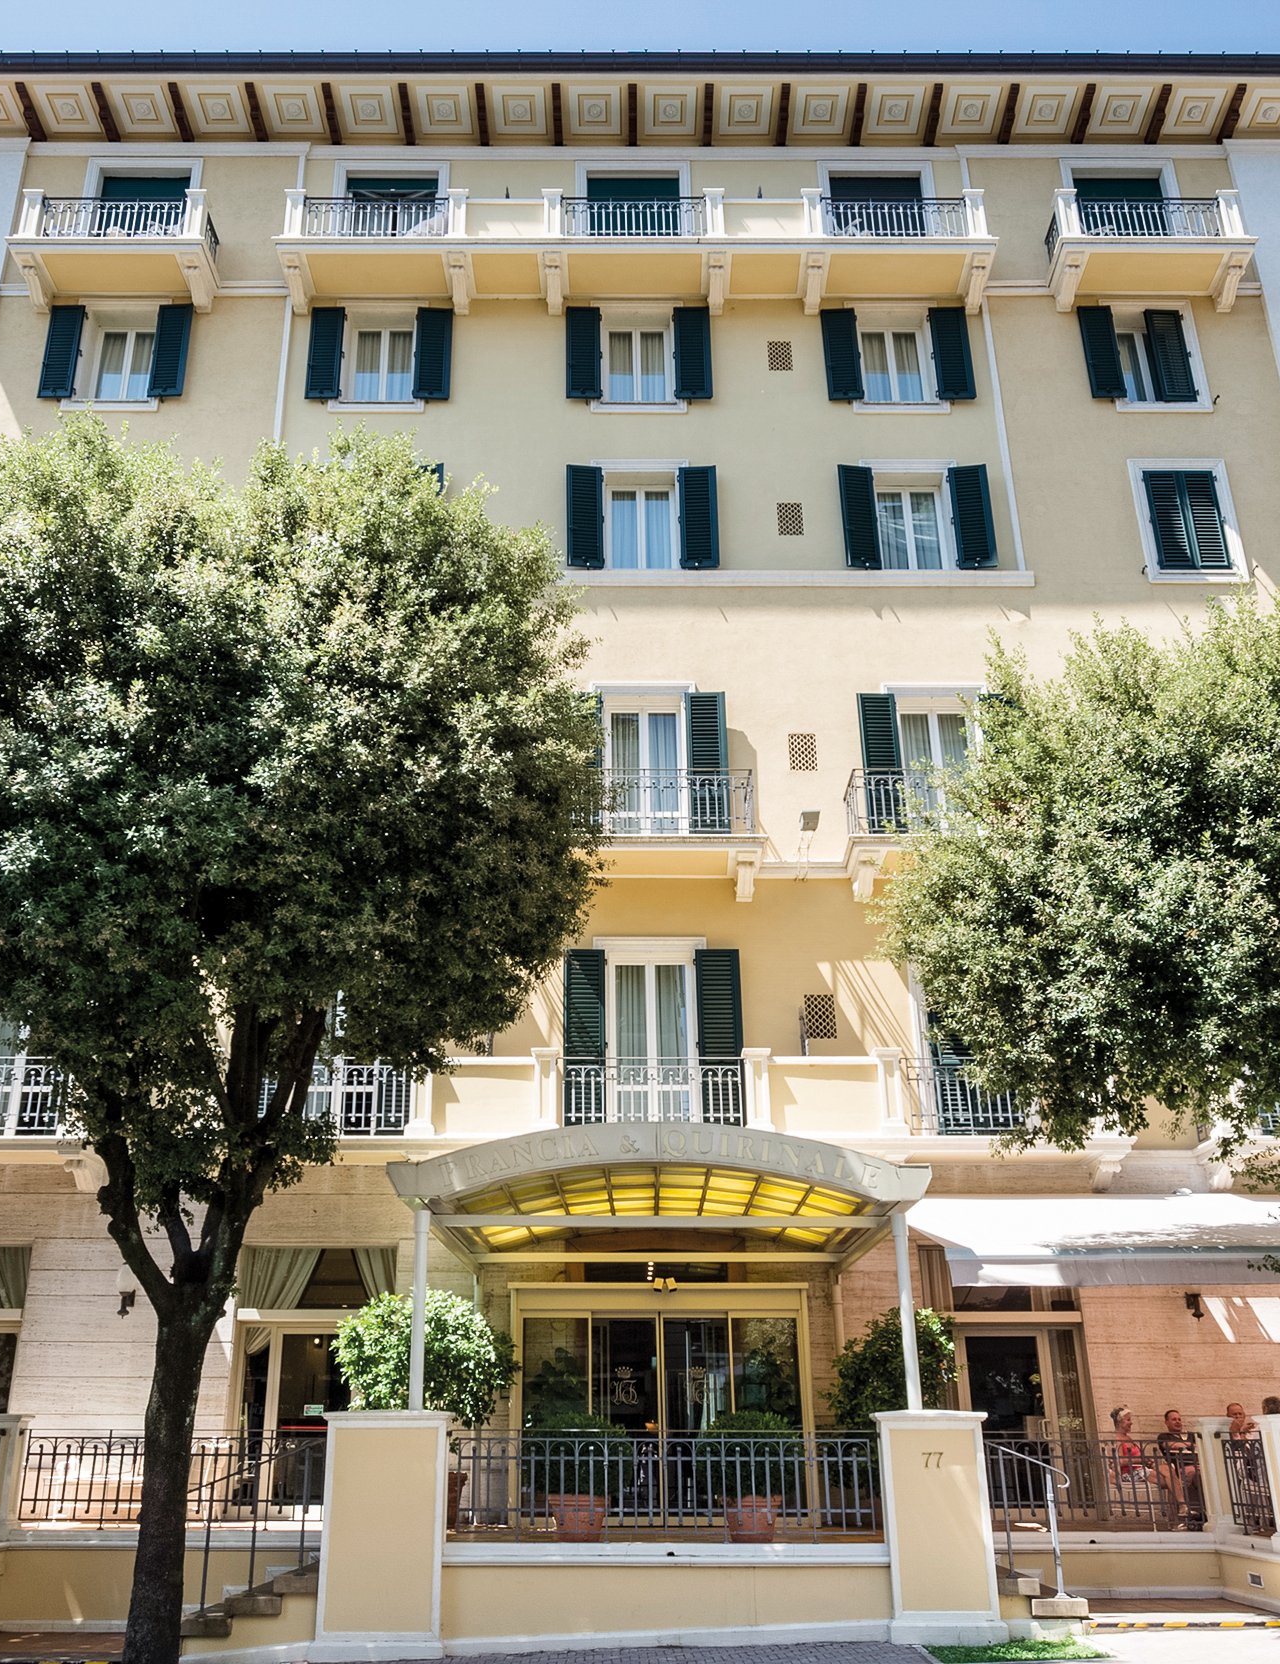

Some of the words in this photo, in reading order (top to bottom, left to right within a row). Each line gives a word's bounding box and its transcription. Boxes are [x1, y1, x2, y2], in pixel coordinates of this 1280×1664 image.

[438, 1133, 599, 1187] FRANCIA
[619, 1134, 640, 1154] &
[663, 1129, 882, 1189] QUIRINALE
[921, 1451, 944, 1469] 77
